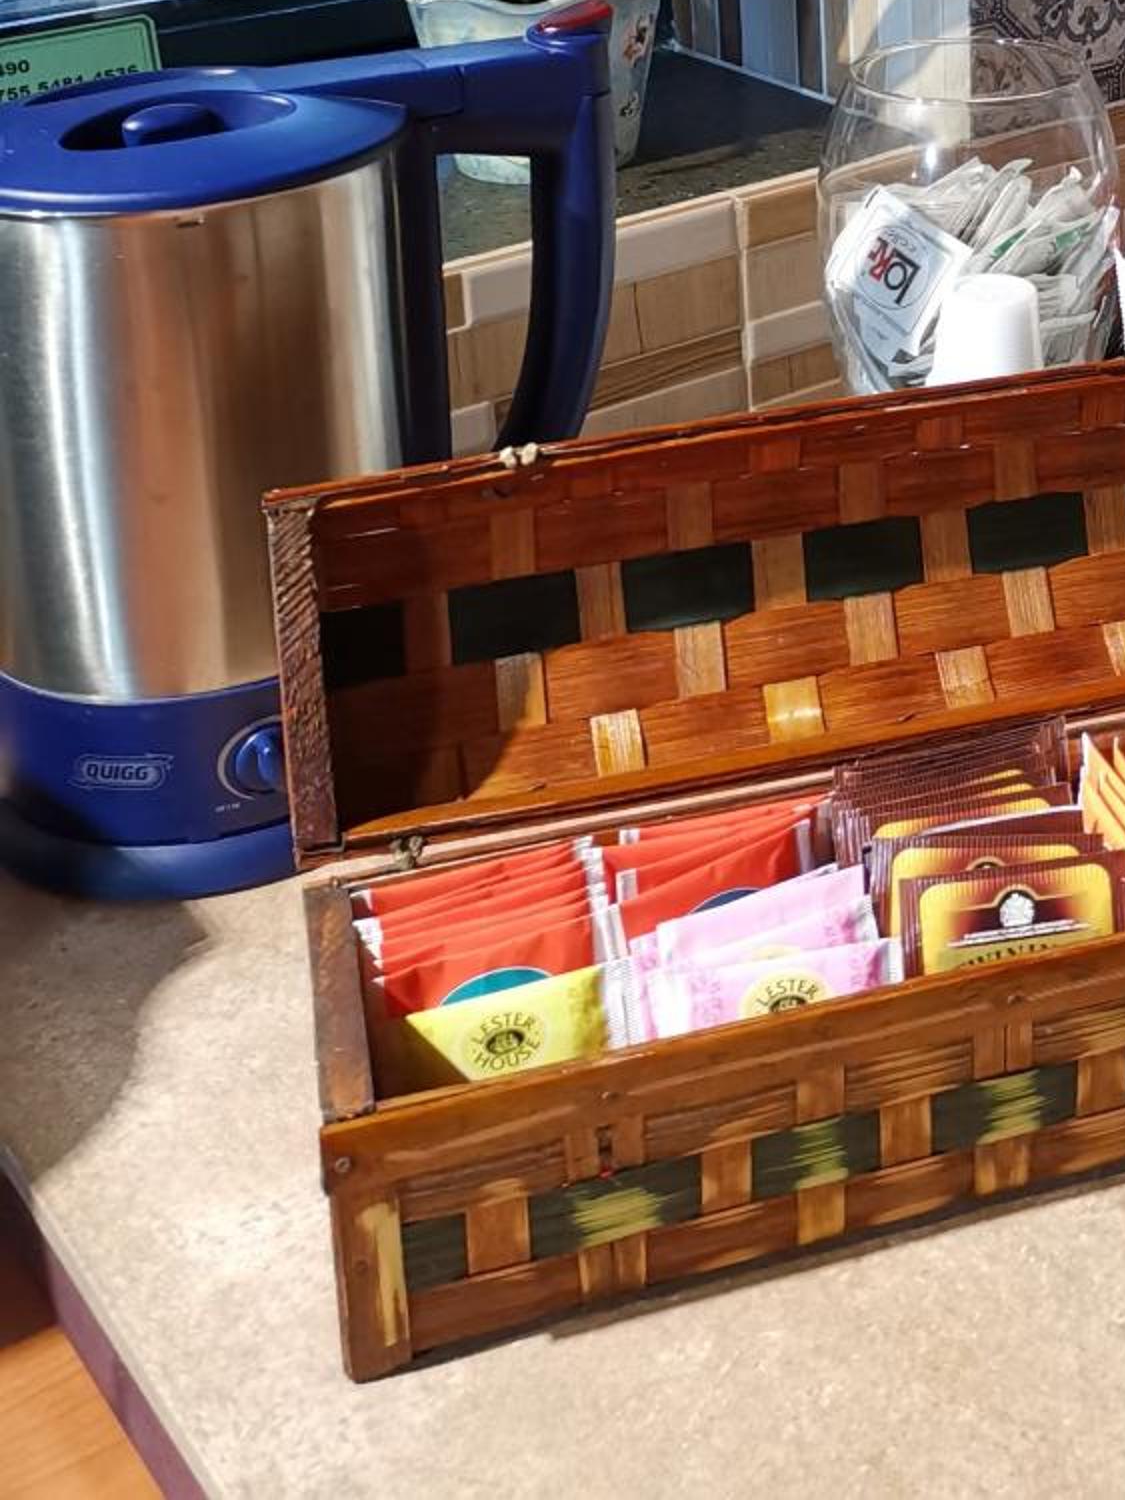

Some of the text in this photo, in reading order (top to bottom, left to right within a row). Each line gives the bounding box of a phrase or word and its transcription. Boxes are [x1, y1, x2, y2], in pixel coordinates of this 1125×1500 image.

[86, 763, 149, 781] QUIGG
[755, 979, 819, 1008] LESTER
[471, 1011, 537, 1046] LESTER
[472, 1037, 541, 1071] HOUSE
